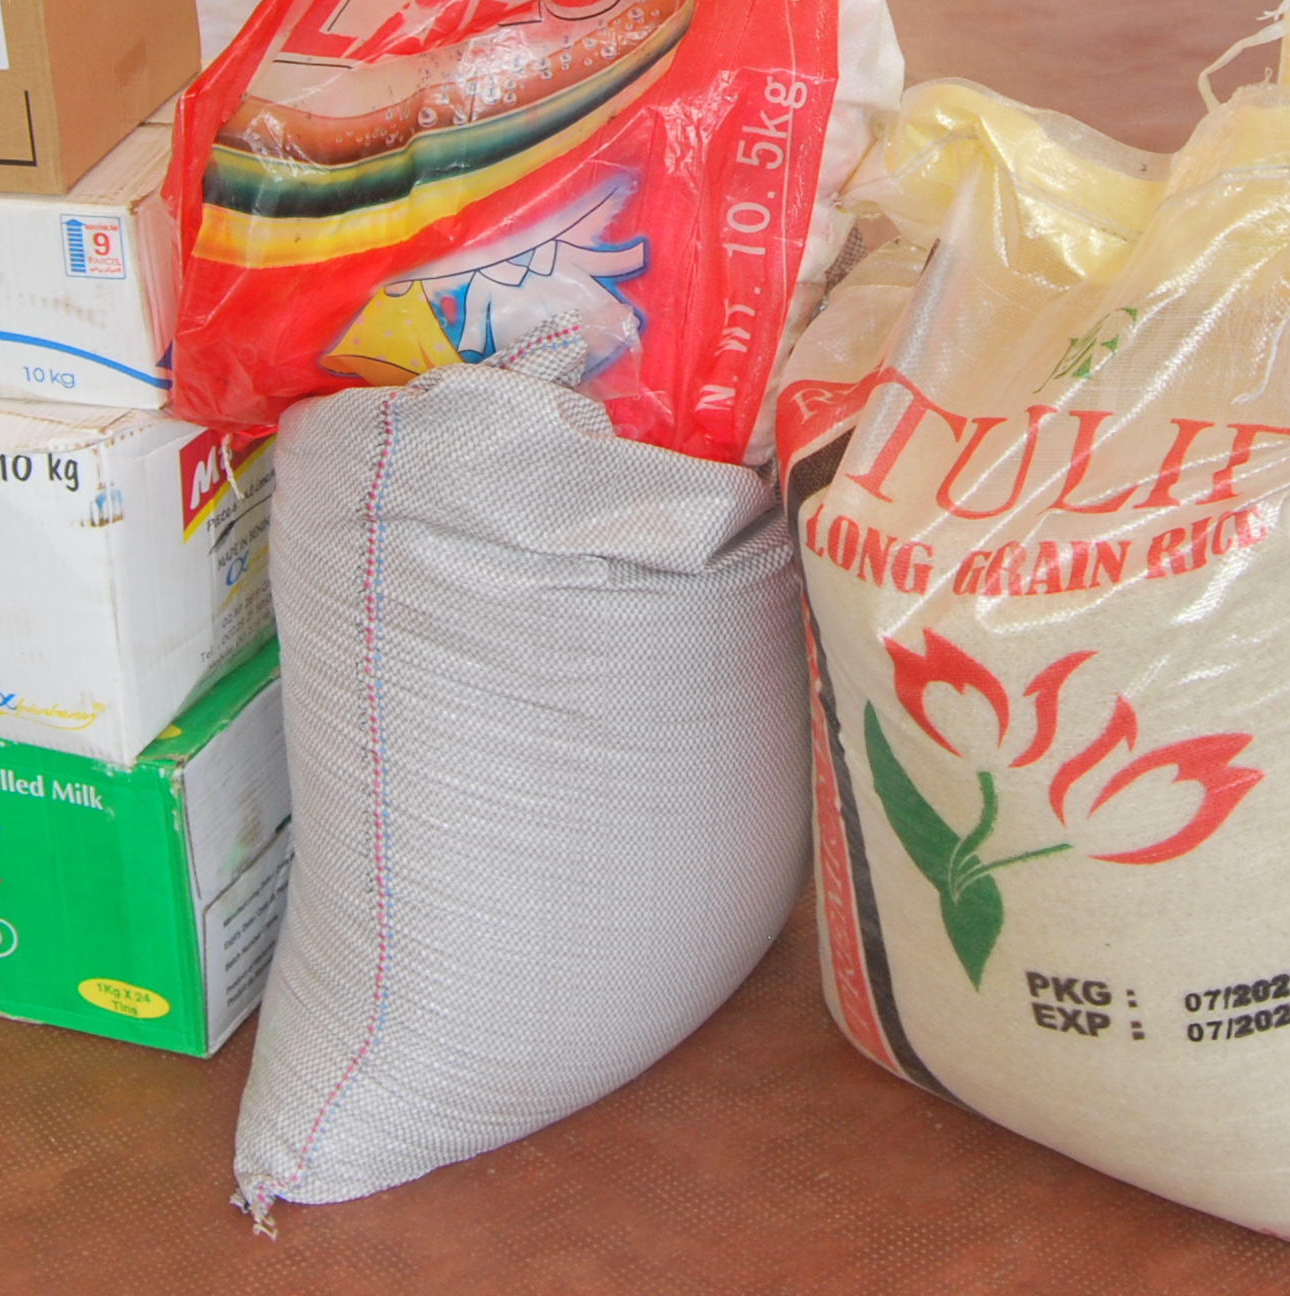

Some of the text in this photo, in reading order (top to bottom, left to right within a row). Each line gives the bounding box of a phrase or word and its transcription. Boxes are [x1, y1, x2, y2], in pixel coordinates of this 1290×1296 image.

[92, 232, 111, 256] 9
[23, 365, 75, 389] 10 kg
[47, 452, 79, 492] kg
[805, 501, 1267, 597] LONG GRAIN RICE
[51, 779, 104, 812] Milk
[97, 982, 151, 1003] 1Kg X 24
[1025, 970, 1113, 1006] PKG
[1031, 1002, 1112, 1038] EXP
